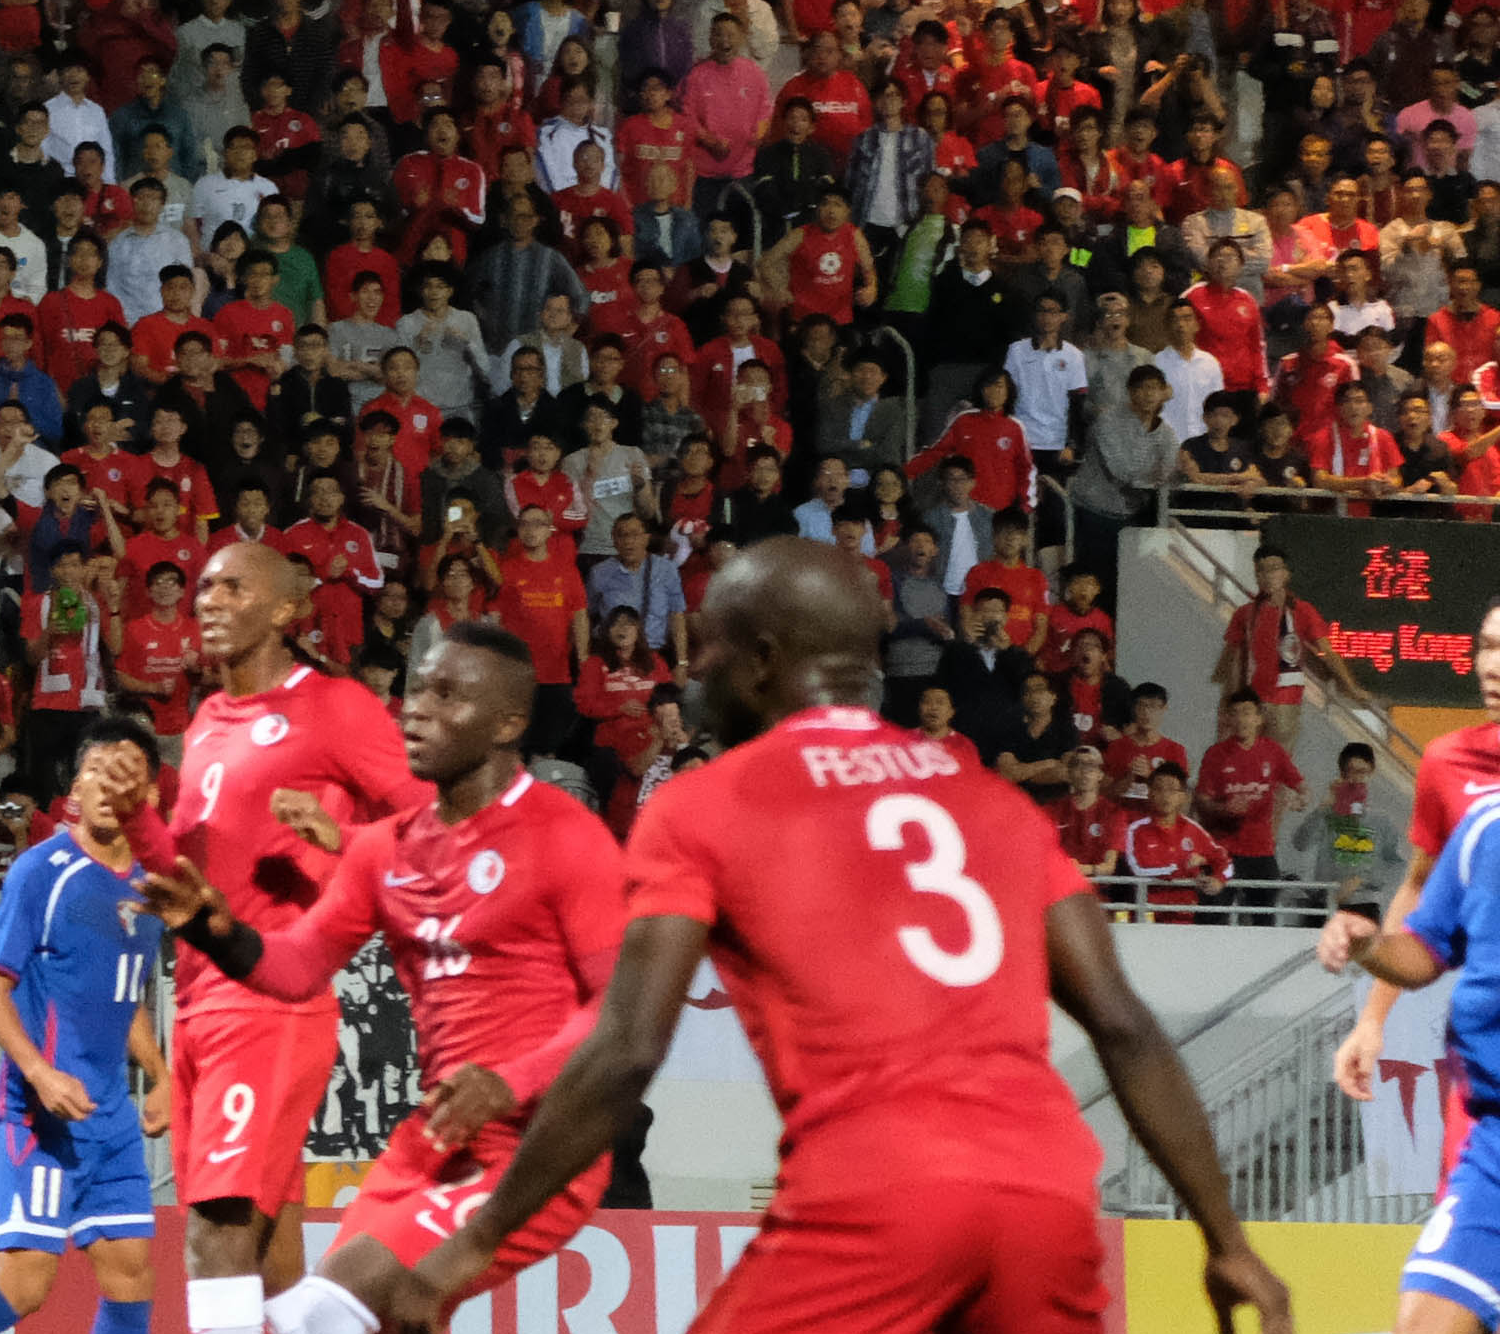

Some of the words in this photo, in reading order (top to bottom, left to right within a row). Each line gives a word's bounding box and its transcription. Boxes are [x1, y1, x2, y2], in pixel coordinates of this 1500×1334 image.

[1361, 545, 1431, 602] 香港
[1398, 623, 1473, 675] Kong
[801, 739, 961, 788] FESTUS
[865, 793, 1005, 988] 3
[113, 953, 144, 1003] 11
[221, 1083, 255, 1143] 9
[30, 1164, 61, 1218] 11
